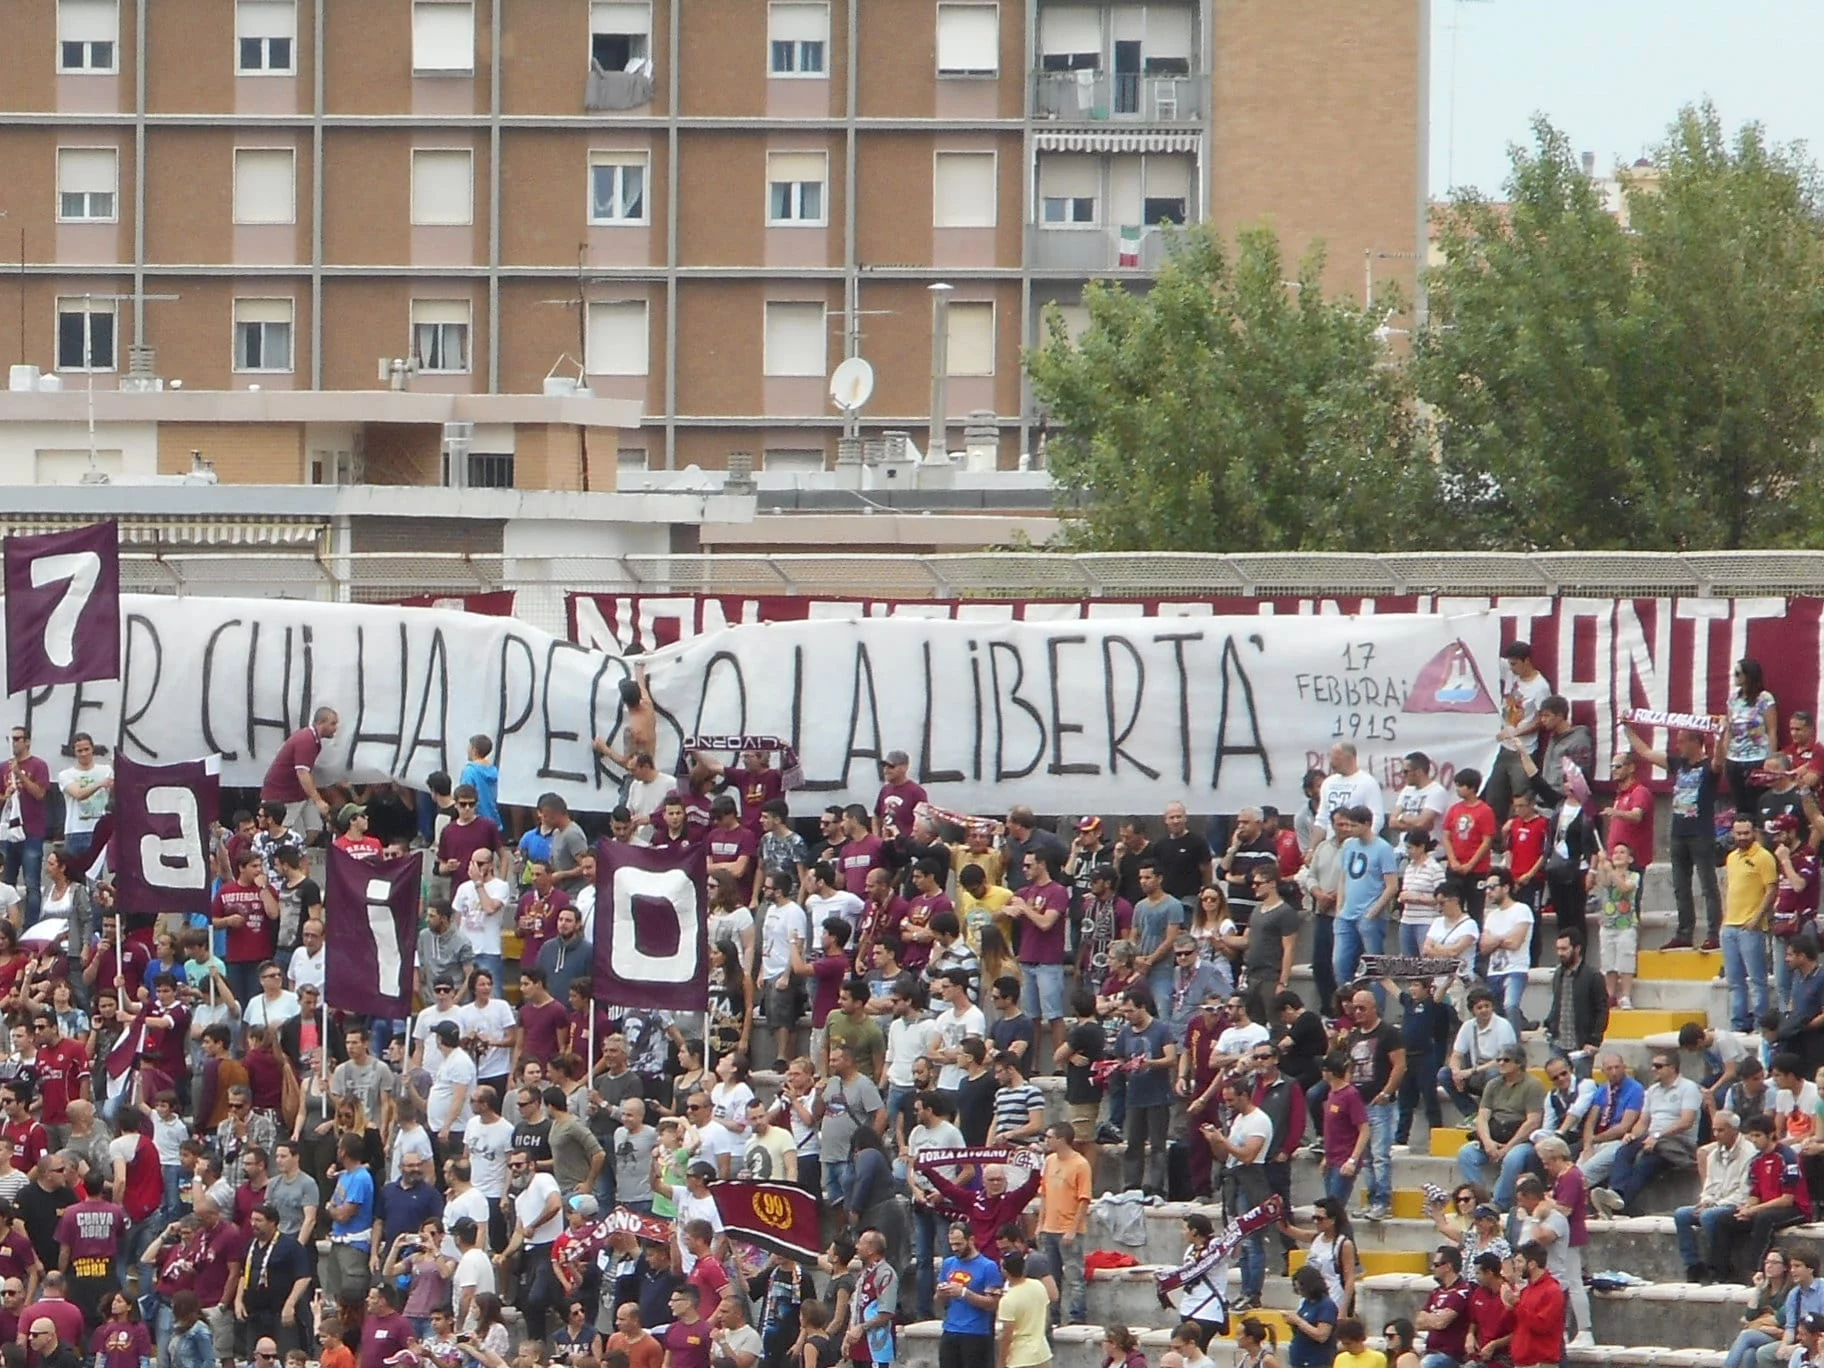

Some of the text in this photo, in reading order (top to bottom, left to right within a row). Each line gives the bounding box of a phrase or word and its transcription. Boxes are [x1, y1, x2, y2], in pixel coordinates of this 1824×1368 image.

[30, 551, 100, 667] 7
[1342, 642, 1376, 671] 17
[1332, 713, 1397, 741] 1915
[1633, 708, 1669, 725] FORZA
[919, 1150, 955, 1164] FORZA
